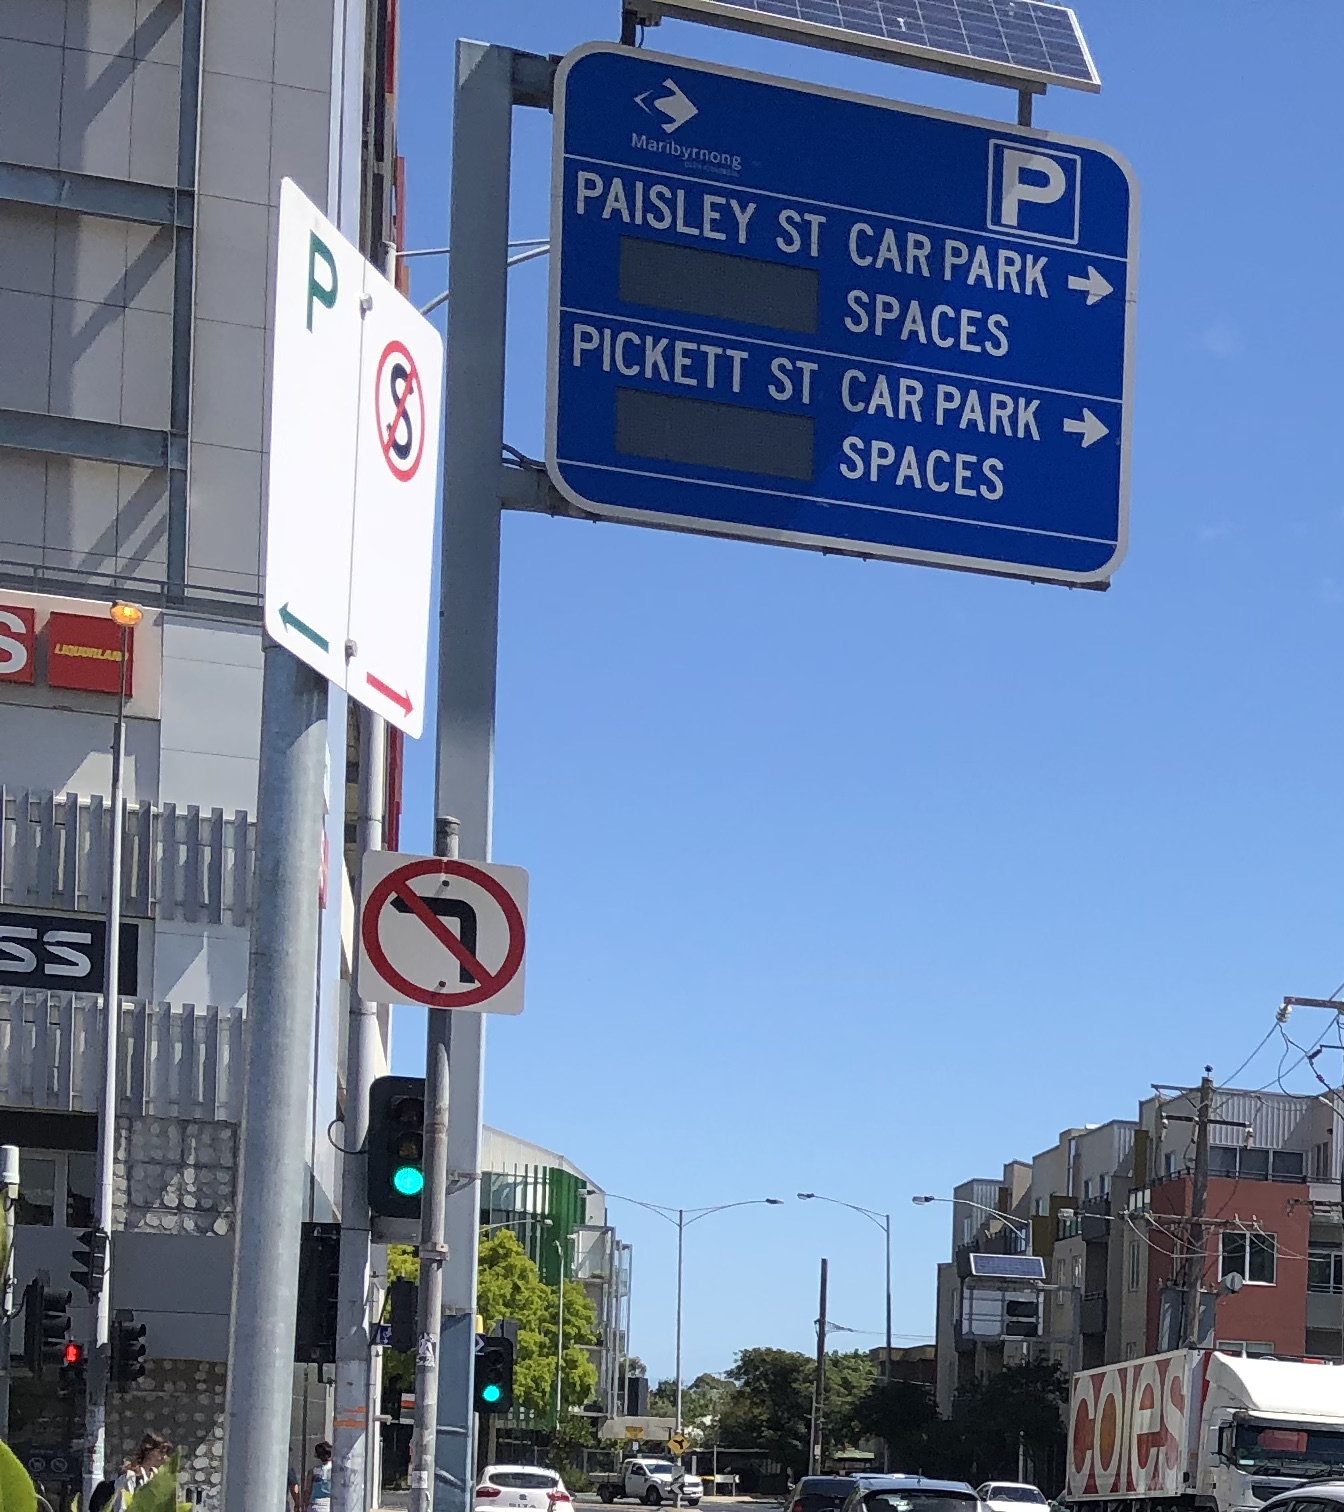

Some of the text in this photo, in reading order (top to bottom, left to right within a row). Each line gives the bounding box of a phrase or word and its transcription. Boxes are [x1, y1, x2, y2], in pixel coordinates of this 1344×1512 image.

[630, 132, 742, 171] Maribyrnong
[1000, 147, 1067, 228] P
[576, 170, 1049, 299] PAISLEY ST CAR PARK
[306, 229, 339, 333] P
[844, 290, 1009, 358] SPACES
[572, 323, 1041, 442] PICKETT ST CAR PARK
[839, 435, 1004, 501] SPACES
[54, 643, 129, 662] LIQUORLAN
[1067, 1350, 1186, 1496] coles
